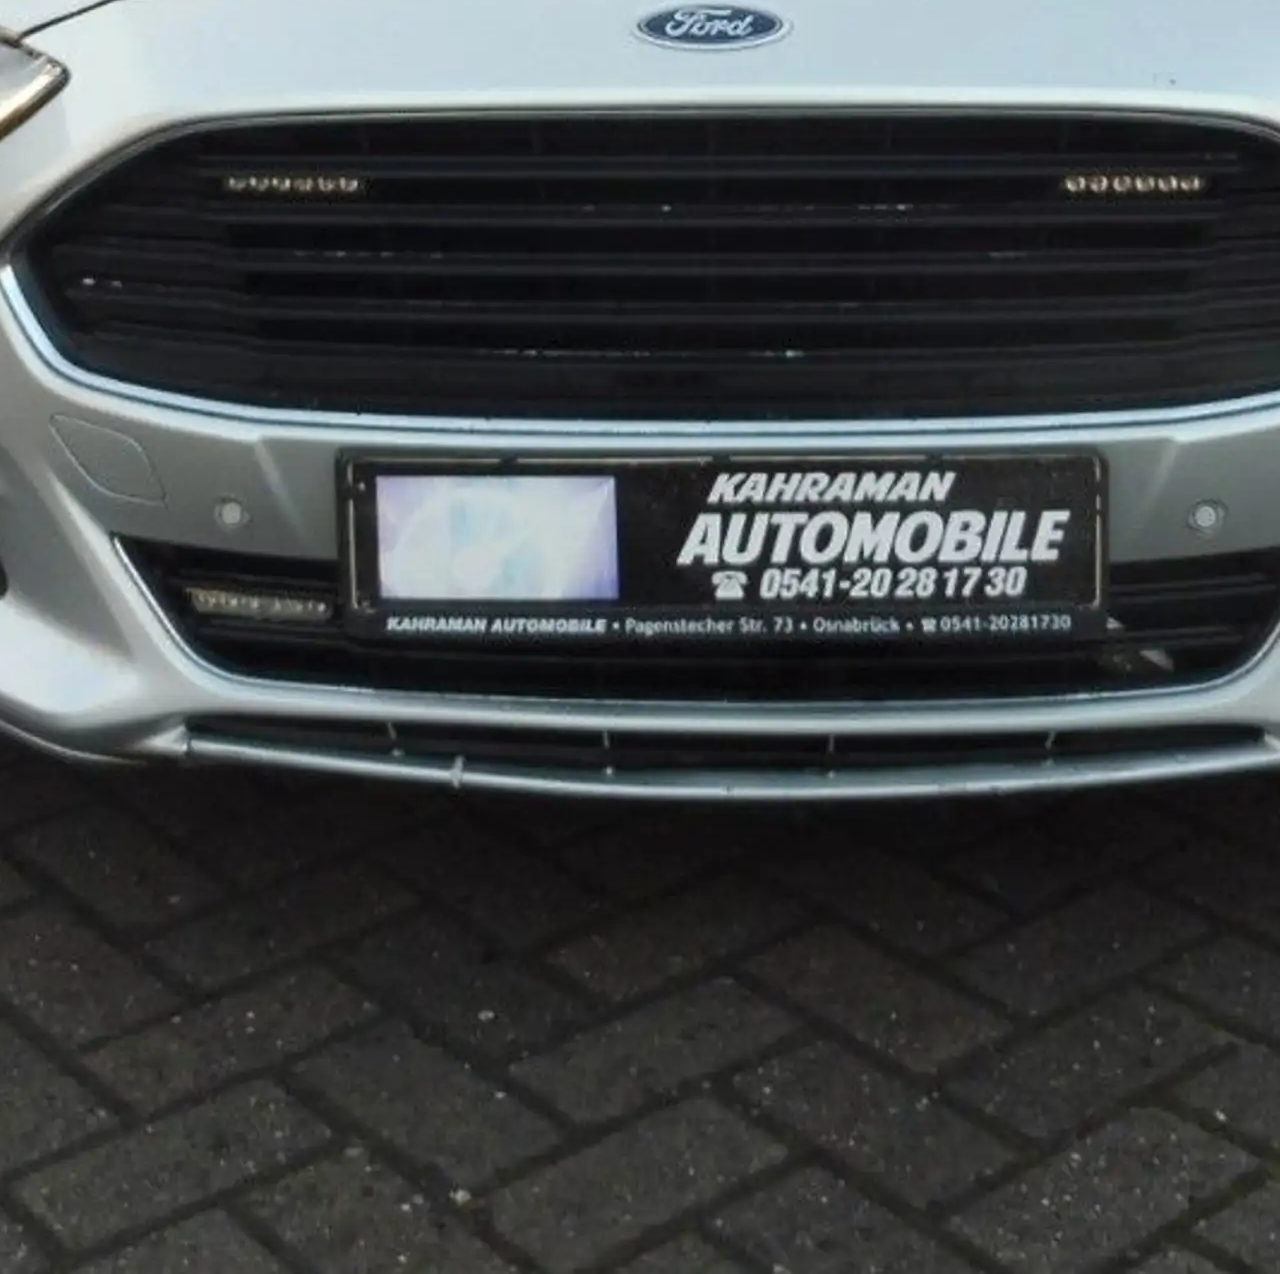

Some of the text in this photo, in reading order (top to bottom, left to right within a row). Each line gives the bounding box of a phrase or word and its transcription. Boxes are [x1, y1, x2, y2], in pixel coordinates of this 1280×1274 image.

[665, 9, 755, 37] Ford
[707, 472, 956, 504] KAHRAMAN
[676, 510, 1071, 566] AUTOMOBILE
[387, 617, 487, 632] KAHRAMAN
[491, 618, 606, 633] AUTOMOBILE
[740, 617, 768, 633] Str.
[774, 617, 793, 633] 73
[813, 616, 901, 634] Osnabrück
[941, 614, 1072, 631] 0541-20281730
